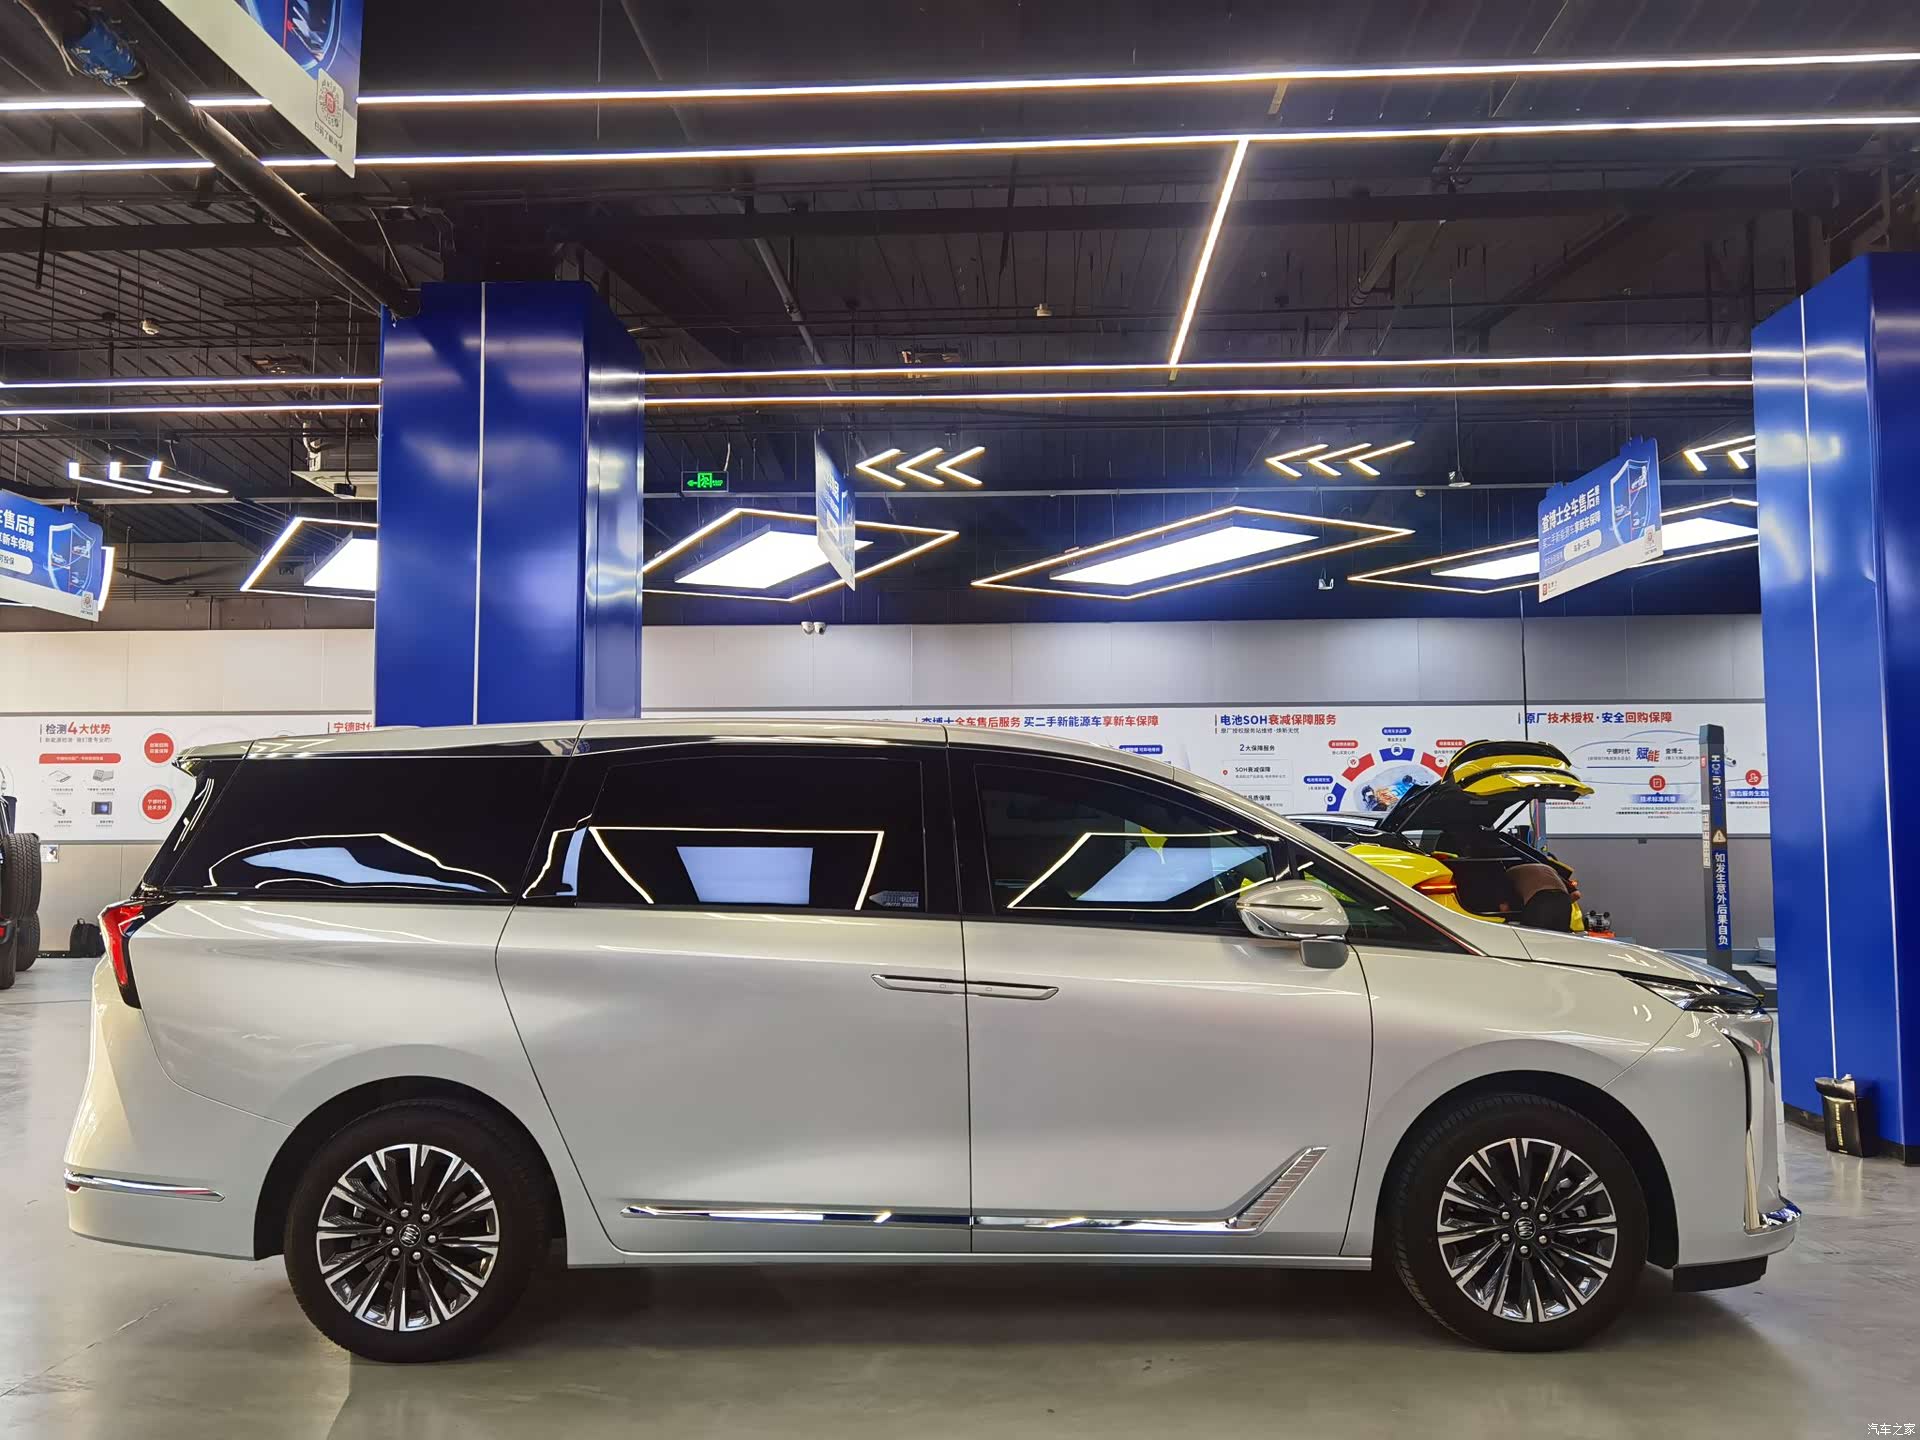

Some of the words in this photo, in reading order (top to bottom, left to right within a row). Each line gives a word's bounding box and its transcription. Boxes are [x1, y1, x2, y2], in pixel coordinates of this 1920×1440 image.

[1024, 715, 1159, 728] 买二手新能源车享新车保障
[1220, 714, 1337, 726] 电池SOH衰减保障服务
[1526, 712, 1673, 724] 原厂技术授权·安全回购保障
[45, 721, 111, 735] 检测4大优势
[1239, 743, 1276, 752] 2大保障服务
[1635, 746, 1661, 763] 赋能
[1234, 766, 1271, 774] SOH衰减保障
[1714, 852, 1729, 946] 如发生意外后果自负
